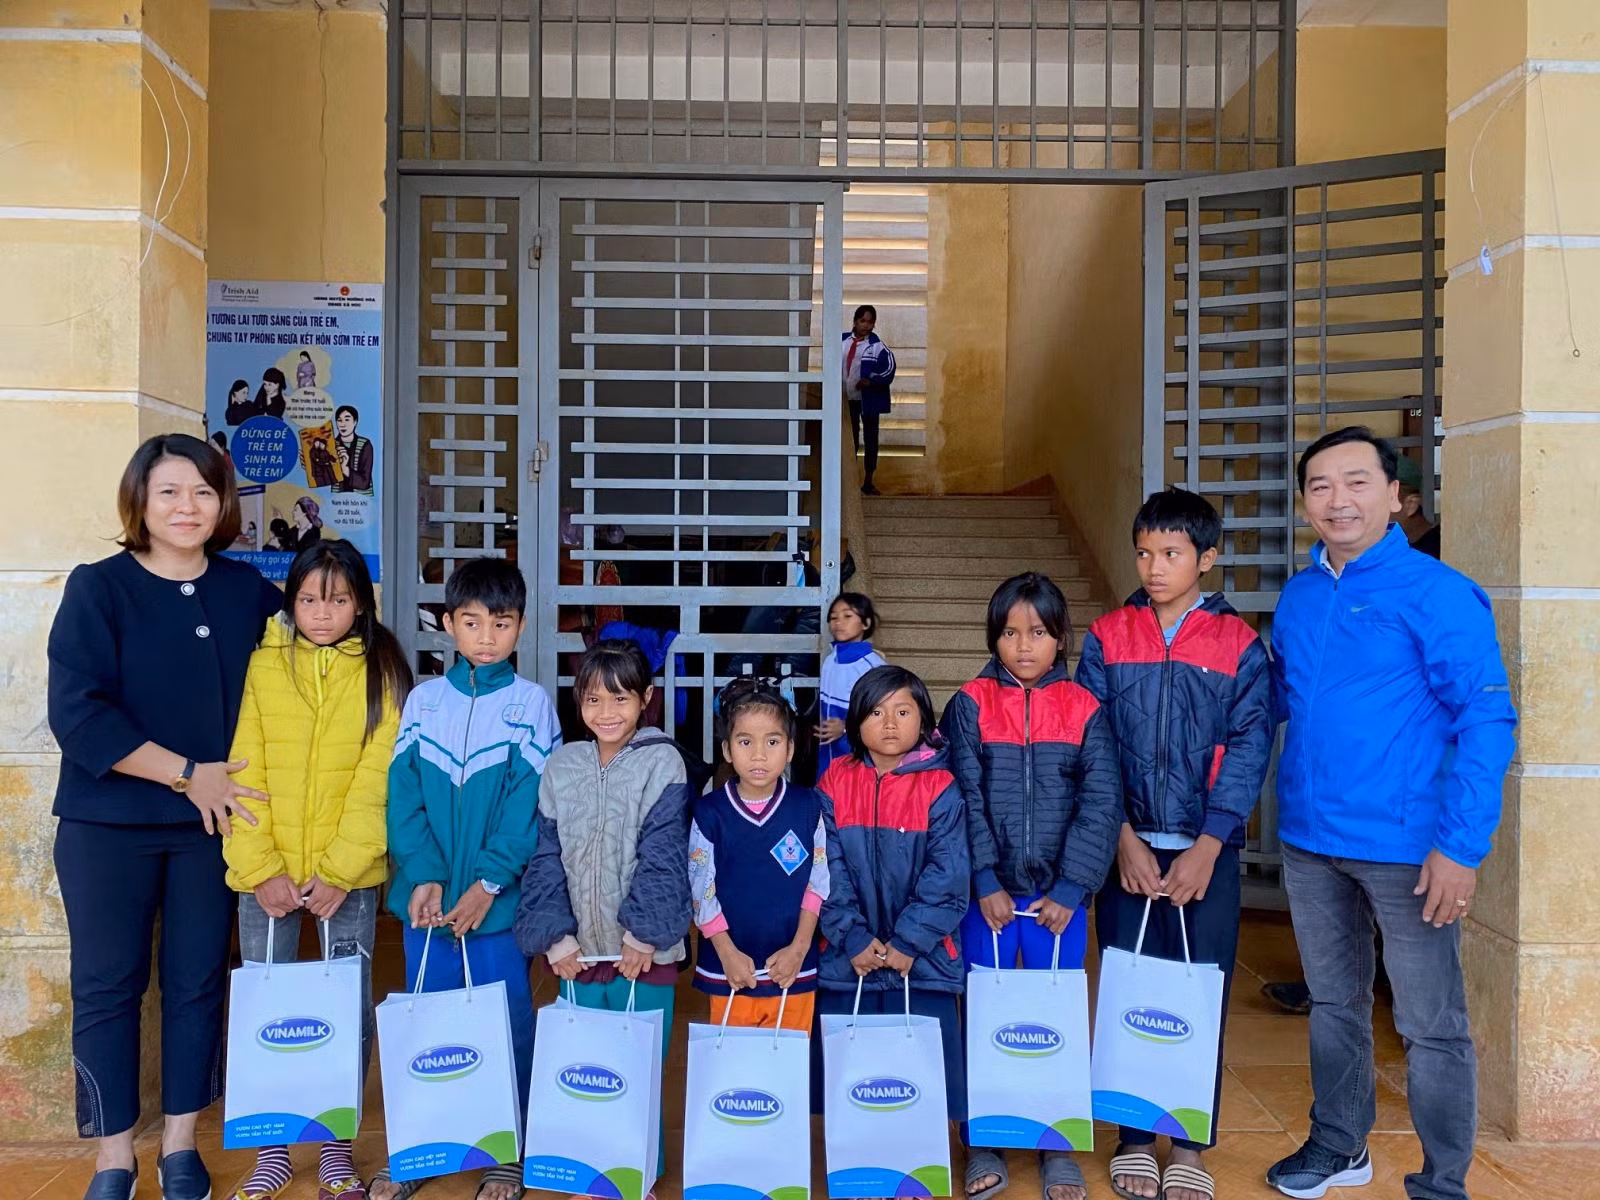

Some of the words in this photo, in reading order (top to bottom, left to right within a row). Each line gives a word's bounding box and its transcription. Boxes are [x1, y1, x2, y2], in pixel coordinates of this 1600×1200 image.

[238, 314, 250, 326] LAI
[310, 312, 324, 327] TRẺ
[207, 332, 232, 342] CHUNG
[234, 332, 248, 343] TAY
[352, 331, 366, 346] TRẺ
[368, 336, 380, 346] EM
[241, 427, 272, 438] ĐỪNG
[248, 440, 266, 451] TRẺ
[268, 442, 284, 452] EM
[244, 454, 268, 464] SINH
[270, 456, 282, 464] RA
[244, 464, 262, 476] TRẺ
[264, 468, 284, 478] EM!
[1128, 1013, 1186, 1034] VINAMILK
[266, 1024, 327, 1039] VINAMILK
[1000, 1032, 1056, 1045] VINAMILK
[414, 1052, 476, 1070] VINAMILK
[564, 1072, 620, 1090] VINAMILK
[855, 1086, 912, 1099] VINAMILK
[718, 1098, 776, 1112] VINAMILK
